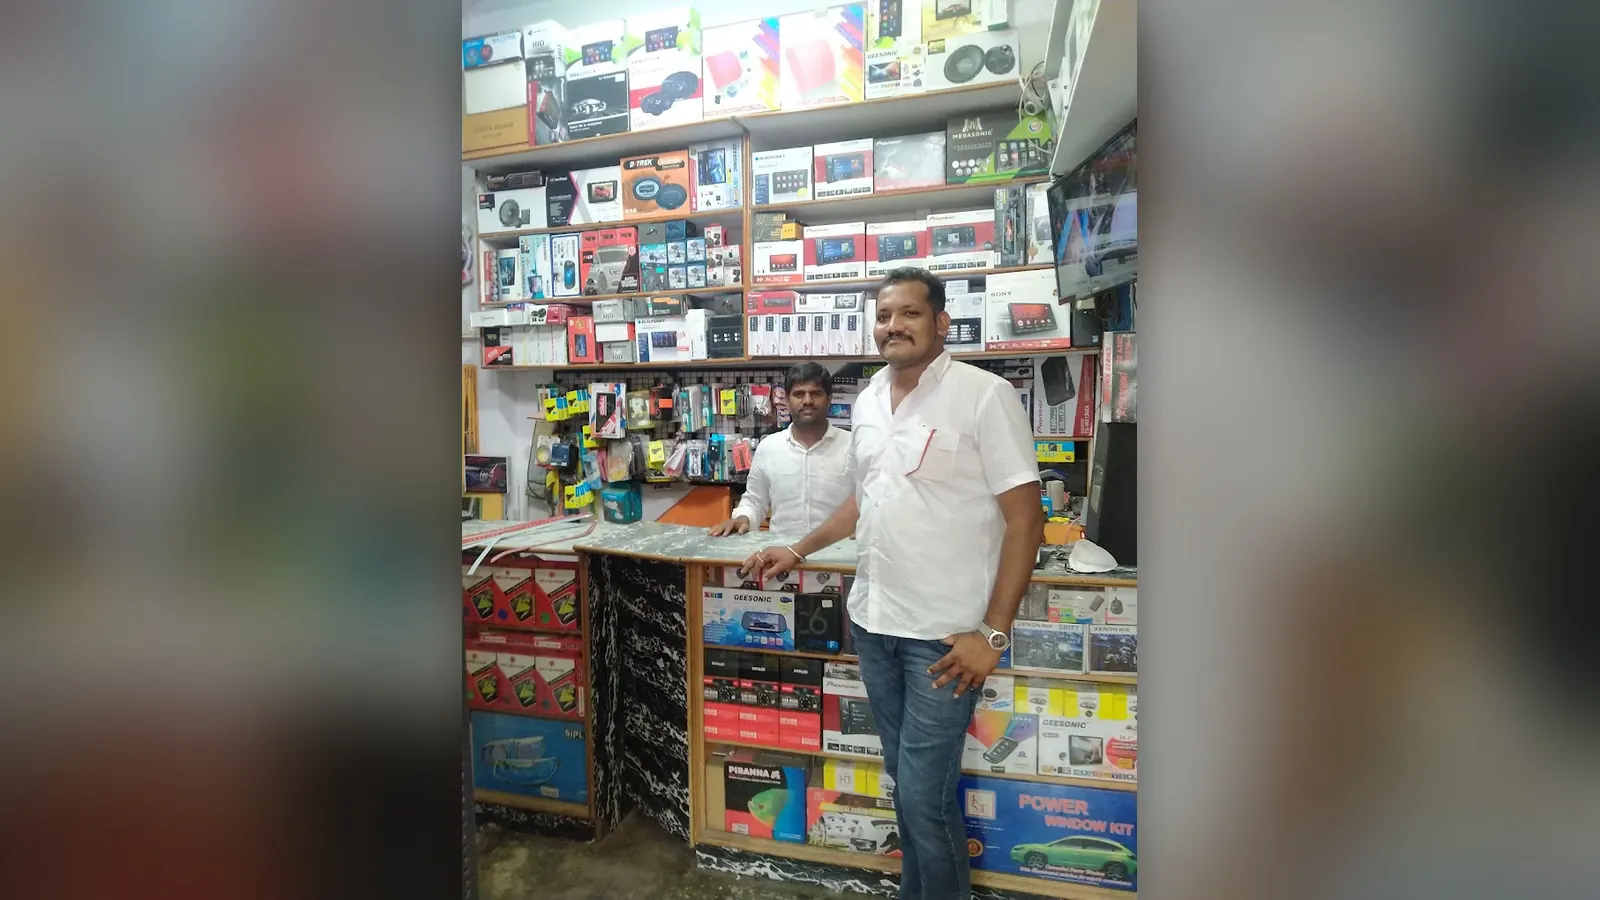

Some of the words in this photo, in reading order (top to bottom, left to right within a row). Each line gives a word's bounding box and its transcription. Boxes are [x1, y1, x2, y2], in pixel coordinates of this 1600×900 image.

[953, 131, 992, 139] MEGASONIC
[733, 594, 771, 603] GEESONIC
[1042, 720, 1086, 728] GEESONIC
[1019, 794, 1089, 816] POWER
[1044, 814, 1107, 833] WINDOW
[1109, 822, 1135, 836] KIT
